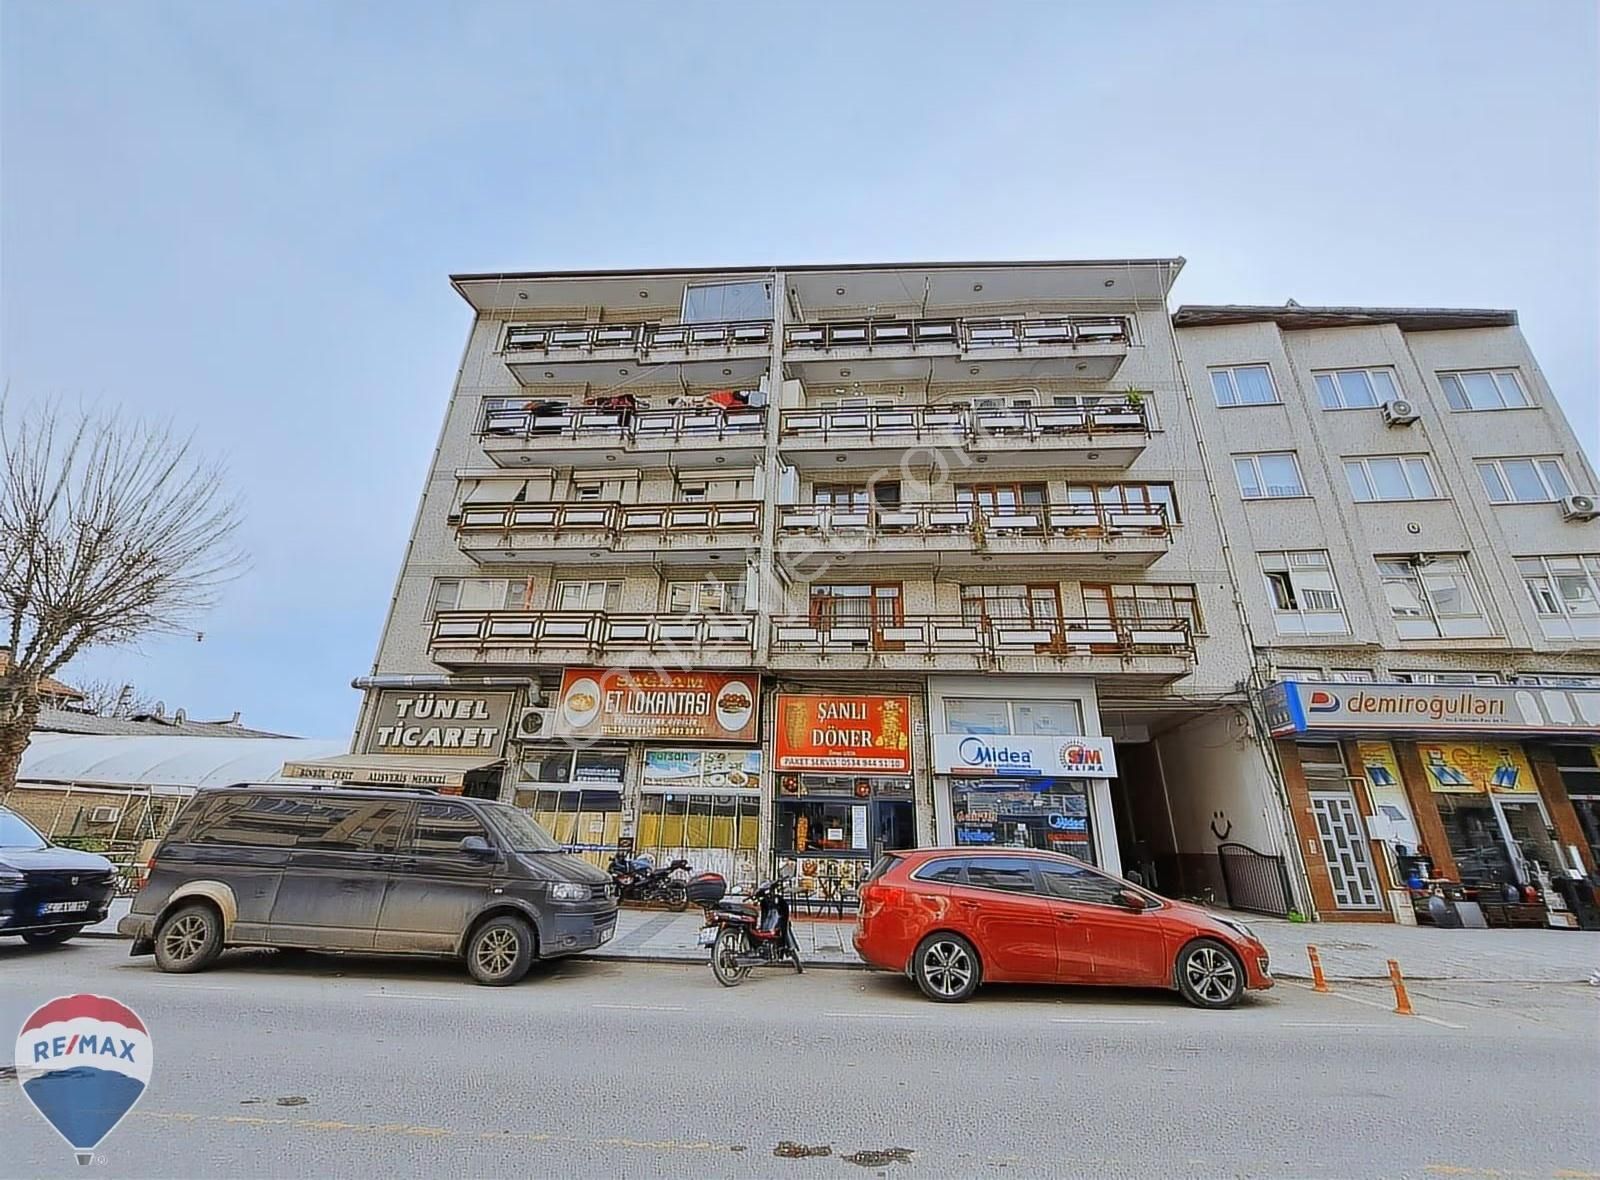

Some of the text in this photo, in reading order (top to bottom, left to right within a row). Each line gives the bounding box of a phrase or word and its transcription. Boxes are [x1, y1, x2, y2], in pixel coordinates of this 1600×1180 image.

[396, 694, 490, 719] TÜNEL
[605, 690, 711, 715] ET LOKANTASI
[817, 702, 868, 723] ŞANLI
[377, 721, 499, 748] TİCARET
[811, 725, 874, 747] DÖNER
[784, 757, 808, 766] PAKET
[961, 740, 1031, 765] Midea
